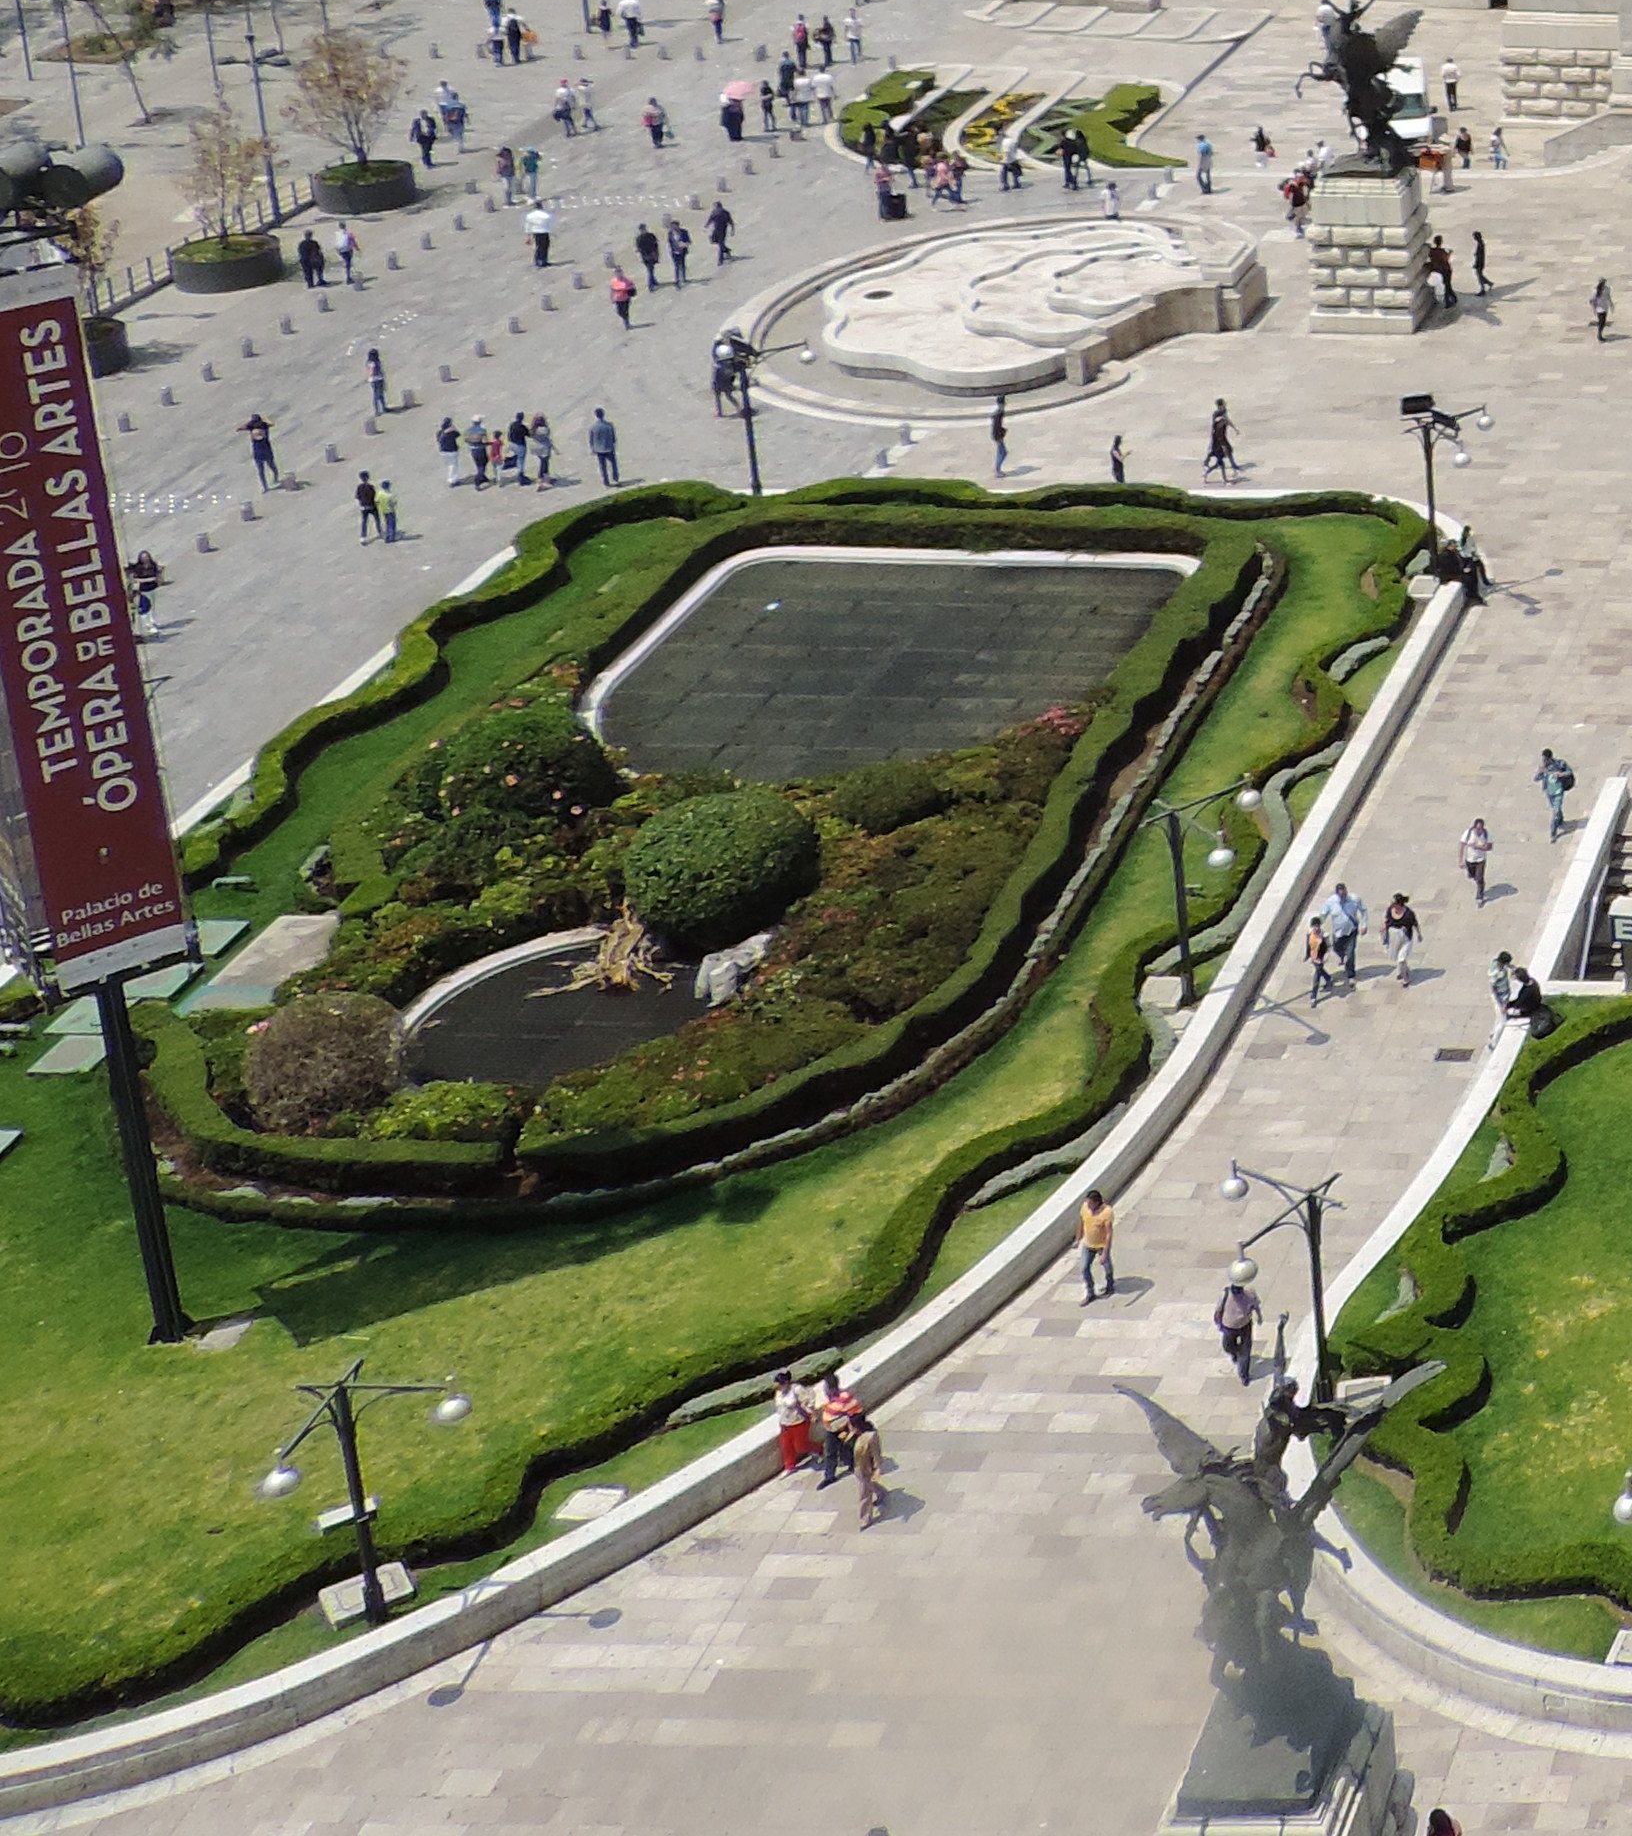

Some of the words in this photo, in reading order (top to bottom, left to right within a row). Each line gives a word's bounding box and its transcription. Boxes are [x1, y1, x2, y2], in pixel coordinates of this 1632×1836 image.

[19, 318, 84, 456] ARTES
[45, 468, 112, 634] BELLAS
[4, 529, 78, 784] TEMPORADA
[76, 635, 116, 663] DE
[77, 663, 138, 813] ÓPERA
[56, 919, 116, 950] Bellas
[120, 899, 176, 929] Artes
[60, 891, 134, 926] Palacio
[137, 881, 164, 900] de
